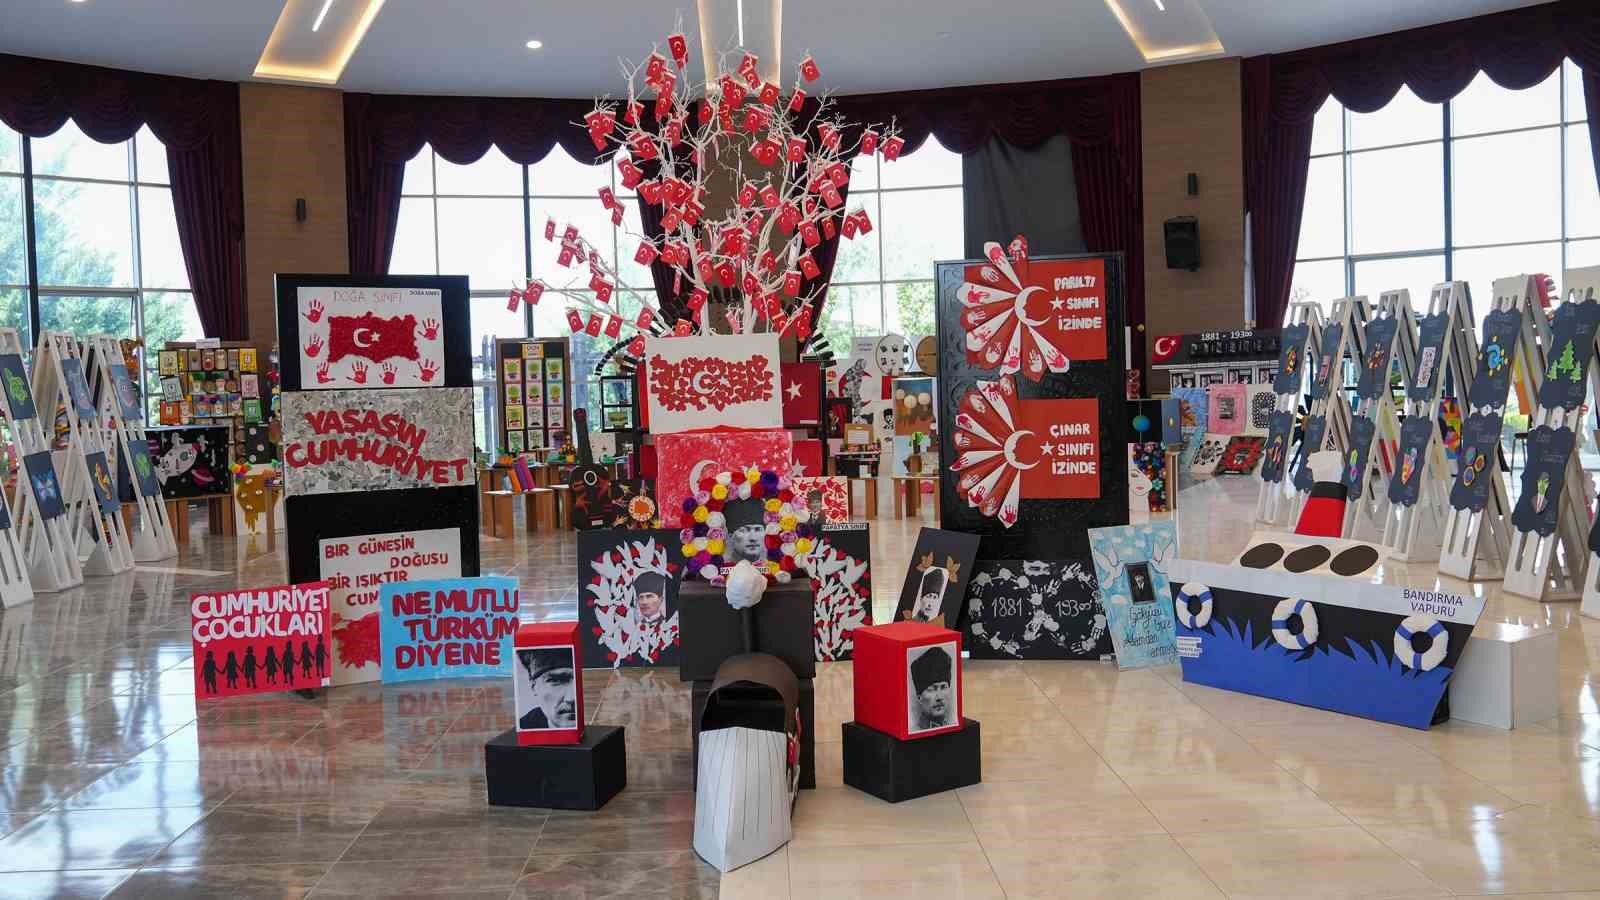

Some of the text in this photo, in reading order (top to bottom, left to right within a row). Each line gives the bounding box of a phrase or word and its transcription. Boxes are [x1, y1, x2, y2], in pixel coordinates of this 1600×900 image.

[1058, 314, 1102, 331] İZİNDE
[1201, 332, 1220, 341] 1881
[304, 408, 427, 449] YAŞASIN
[1050, 423, 1090, 438] ÇINAR
[1057, 442, 1095, 456] SINIFI
[285, 438, 468, 484] CUMHURİYET
[1052, 458, 1097, 475] İZİNDE
[358, 535, 415, 555] GÜNEŞİN
[327, 570, 408, 590] BİR IŞIKTIR
[191, 585, 330, 619] CUMHURİYET
[392, 588, 519, 617] NE MUTLU
[991, 596, 1022, 617] 1881
[1403, 588, 1464, 606] BANDIRMA
[1411, 602, 1456, 617] VAPURU
[193, 612, 323, 648] ÇOCUKLARI
[403, 612, 520, 642] TÜRKÜM
[395, 640, 501, 670] DİYENE
